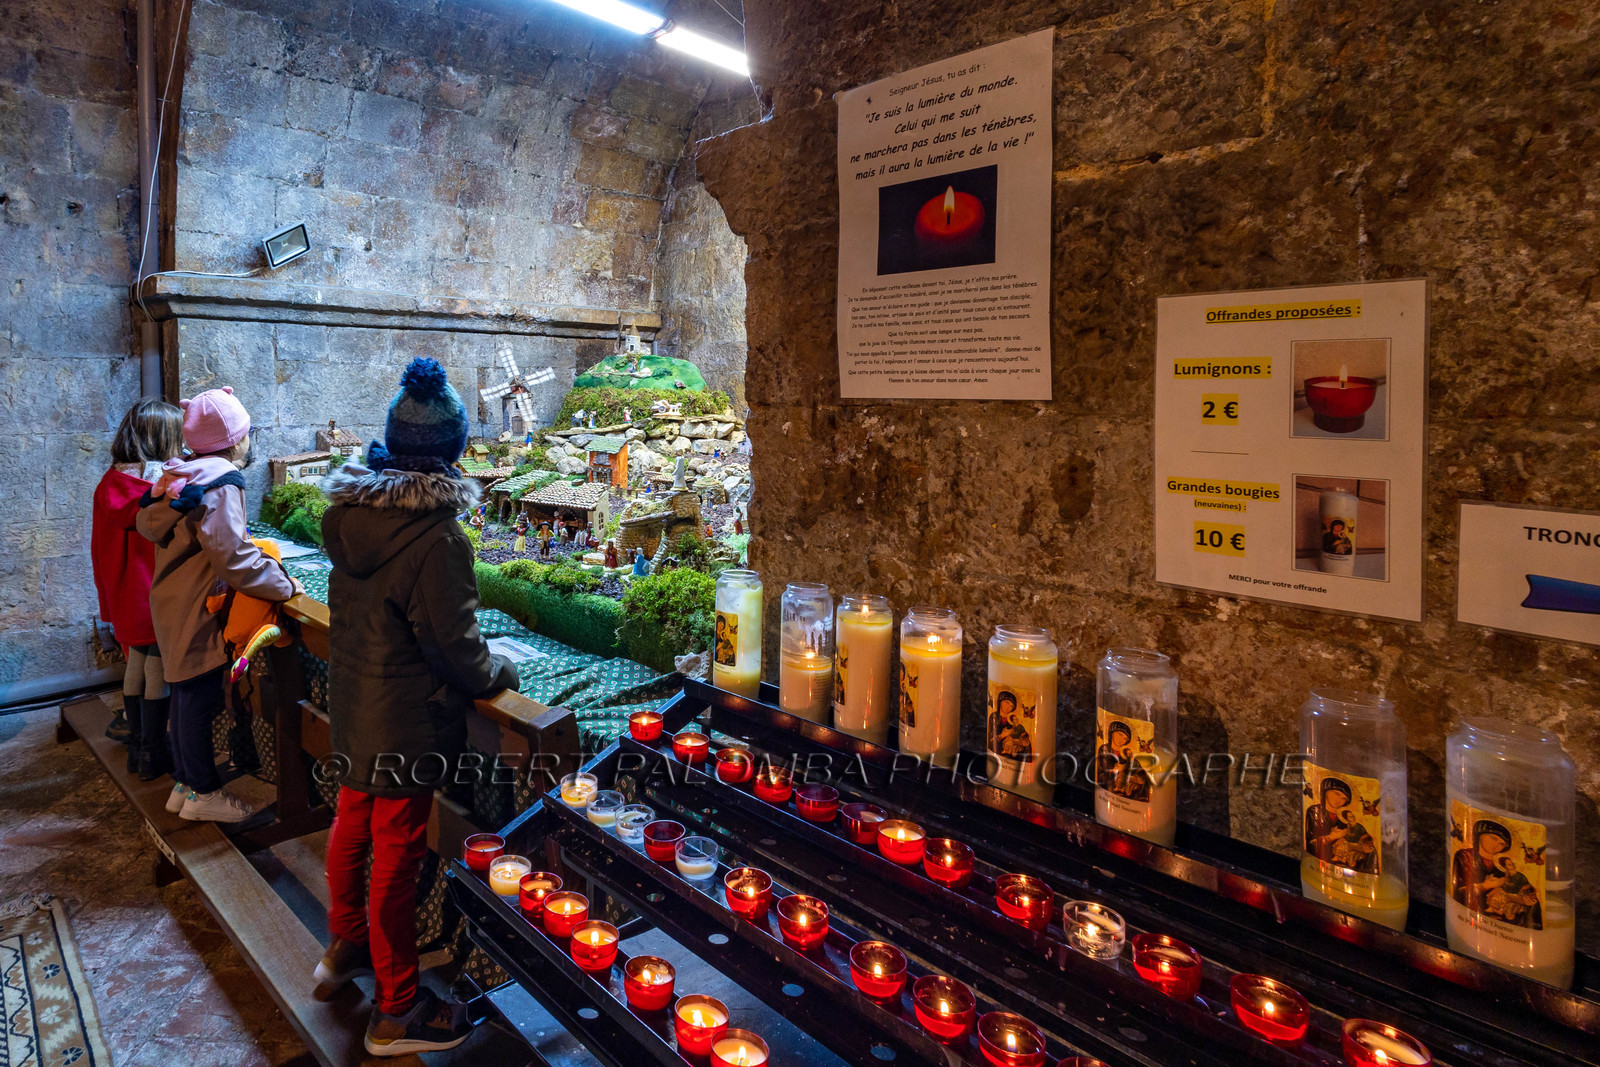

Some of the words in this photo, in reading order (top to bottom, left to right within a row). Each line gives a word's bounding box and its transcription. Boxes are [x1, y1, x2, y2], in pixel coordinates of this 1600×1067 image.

[889, 82, 919, 96] Seigneur
[921, 75, 944, 87] Jésus,
[947, 71, 955, 79] tu
[969, 64, 980, 74] dit
[866, 112, 880, 123] "Je
[884, 106, 901, 119] suis
[906, 103, 914, 112] la
[918, 92, 955, 109] lumière
[960, 86, 973, 98] du
[978, 75, 1018, 93] monde.
[895, 120, 917, 134] Celui
[921, 118, 936, 130] qui
[940, 114, 954, 122] me
[959, 104, 981, 118] suit
[850, 154, 860, 163] ne
[864, 143, 907, 161] marchera
[911, 140, 928, 152] pas
[933, 131, 956, 144] dans
[961, 126, 976, 137] les
[982, 112, 1036, 132] ténèbres,
[856, 169, 875, 180] mais
[879, 165, 884, 175] il
[889, 163, 909, 174] aura
[914, 158, 922, 167] la
[927, 148, 964, 165] lumière
[970, 144, 982, 156] de
[988, 142, 997, 152] la
[1003, 138, 1019, 148] vie
[1024, 132, 1034, 144] !"
[1206, 308, 1271, 322] Offrandes
[1276, 304, 1351, 320] proposées
[1174, 363, 1260, 377] Lumignons
[1168, 480, 1221, 494] Grandes
[1226, 484, 1280, 499] bougies
[1194, 500, 1241, 511] (neuvaines)
[1196, 529, 1223, 547] 10
[1229, 574, 1251, 582] MERCI
[1253, 578, 1270, 586] pour
[1272, 581, 1292, 589] votre
[1294, 584, 1327, 593] offrande
